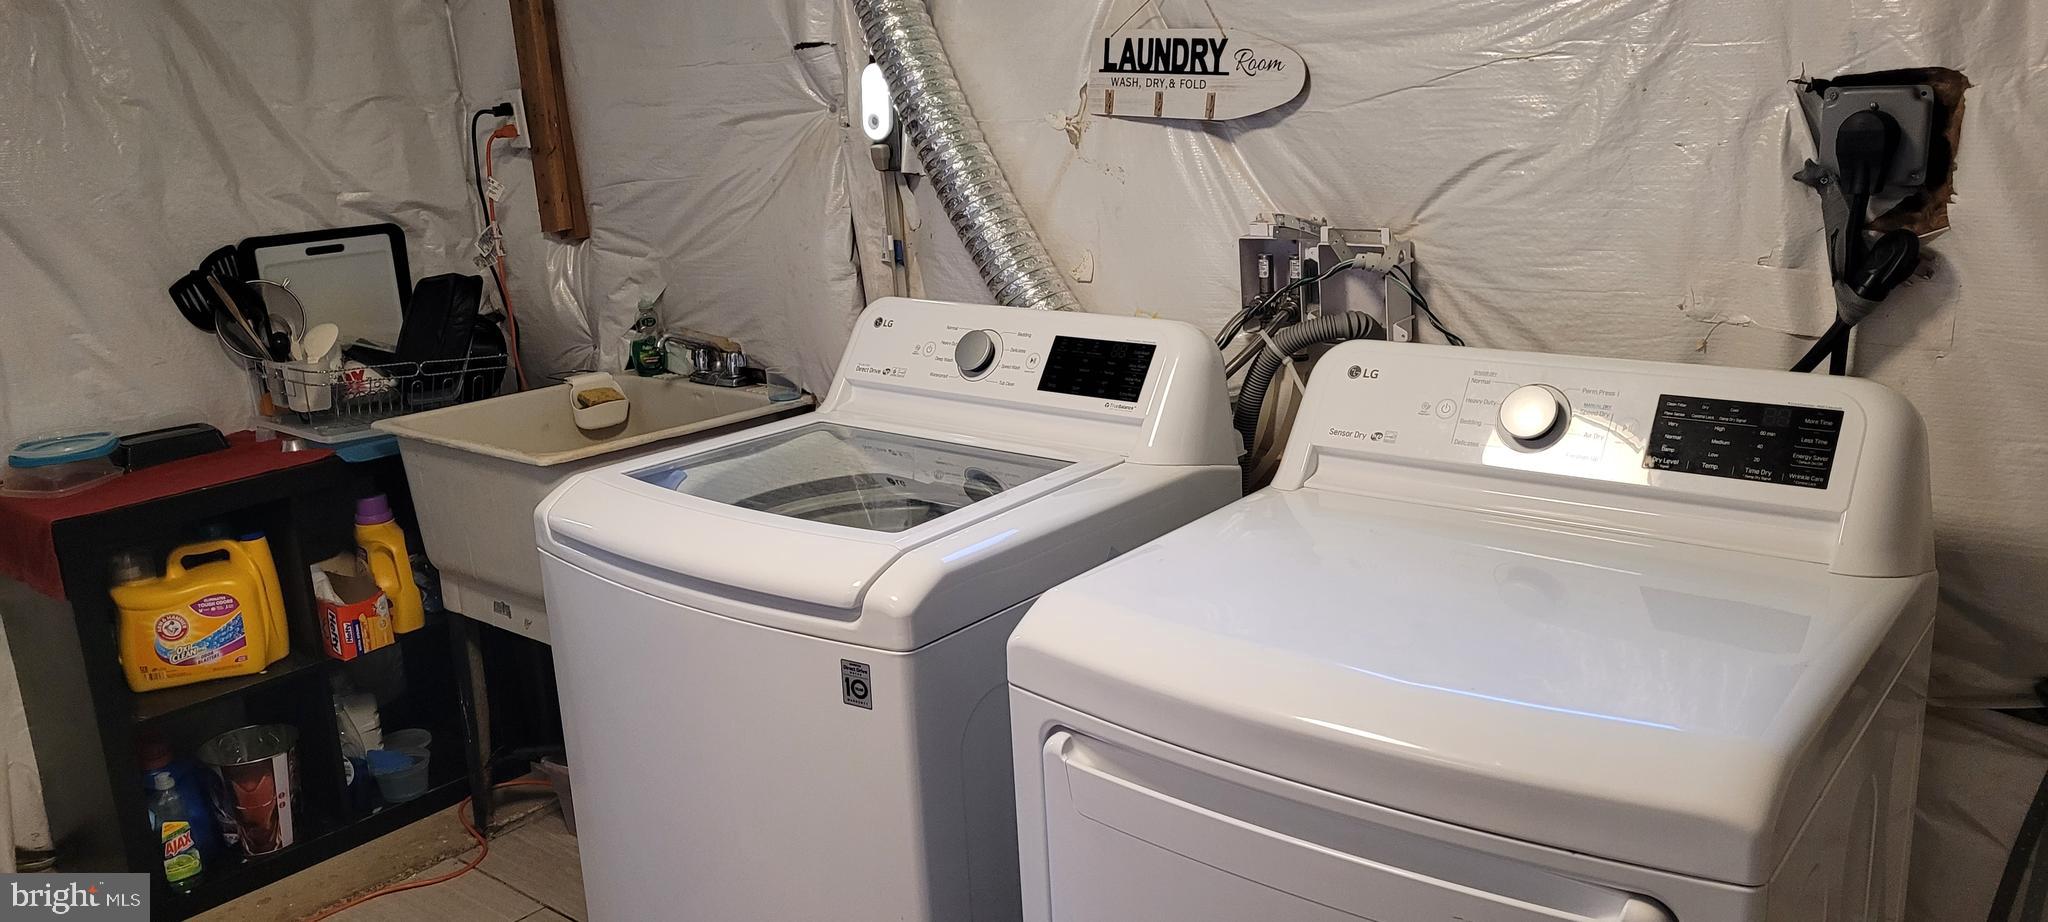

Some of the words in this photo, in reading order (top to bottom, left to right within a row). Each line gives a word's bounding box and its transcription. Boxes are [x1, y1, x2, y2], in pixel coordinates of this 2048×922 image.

[1103, 37, 1229, 73] LAUNDRY
[1234, 48, 1286, 77] Room
[1110, 77, 1142, 88] WASH,
[1179, 79, 1207, 89] FOLD
[882, 319, 894, 328] LG
[1362, 368, 1379, 379] LG
[1471, 377, 1491, 385] Normal
[1582, 387, 1598, 395] Perm
[1599, 389, 1616, 397] Press
[1460, 418, 1482, 427] Bedding
[1667, 420, 1678, 428] Very
[1820, 419, 1834, 427] Time
[1328, 427, 1353, 438] Sensor
[1354, 430, 1367, 440] Dry
[1453, 438, 1480, 447] Delicates
[1711, 438, 1730, 446] Medium
[1815, 438, 1828, 446] Time
[1663, 457, 1679, 465] Level
[1792, 452, 1812, 461] Energy
[1745, 467, 1760, 475] Time
[1760, 469, 1772, 477] Dry
[1789, 473, 1810, 481] Wrinkle
[328, 609, 341, 654] Hefty
[345, 623, 353, 643] Hefty
[171, 647, 198, 662] CLEAN
[176, 644, 193, 655] OXI
[845, 677, 868, 699] 10
[165, 830, 192, 856] AJAX
